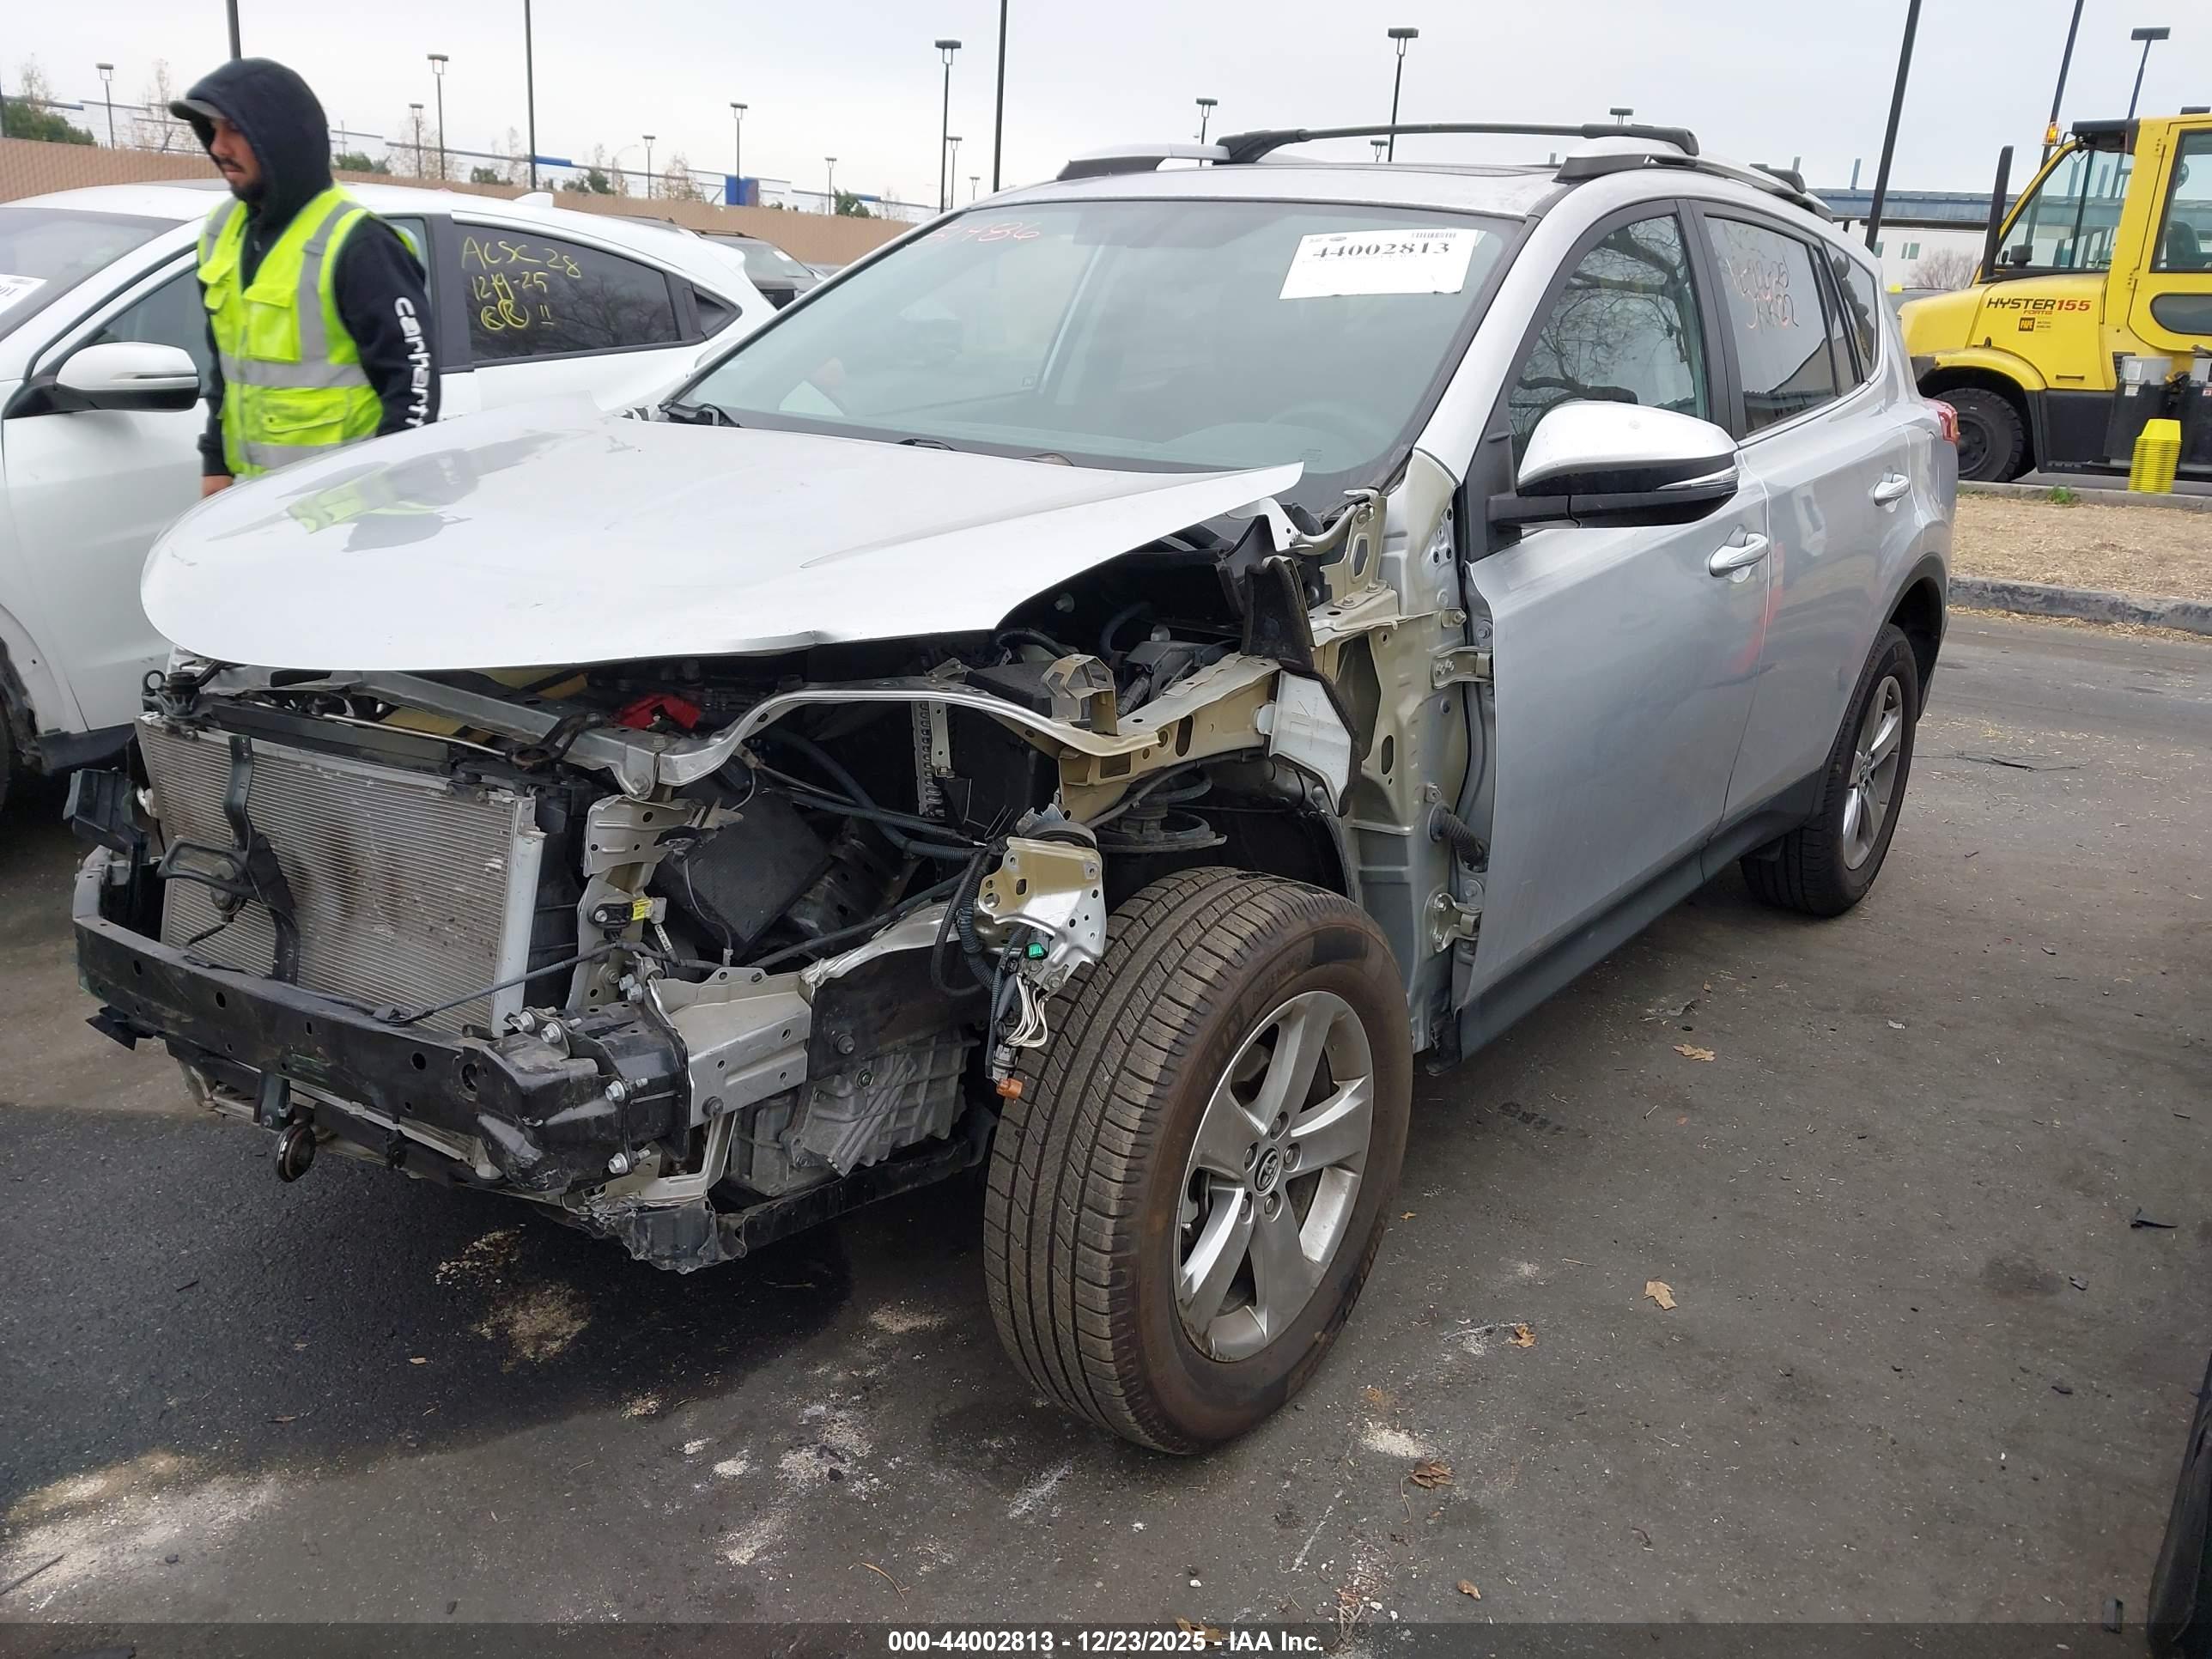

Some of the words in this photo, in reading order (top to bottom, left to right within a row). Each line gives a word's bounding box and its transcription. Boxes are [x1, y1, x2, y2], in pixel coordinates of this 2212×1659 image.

[1312, 241, 1449, 258] 44002813
[544, 247, 581, 278] 28
[1986, 297, 2057, 310] HYSTER
[2057, 299, 2092, 312] 155
[394, 296, 431, 428] carhartt
